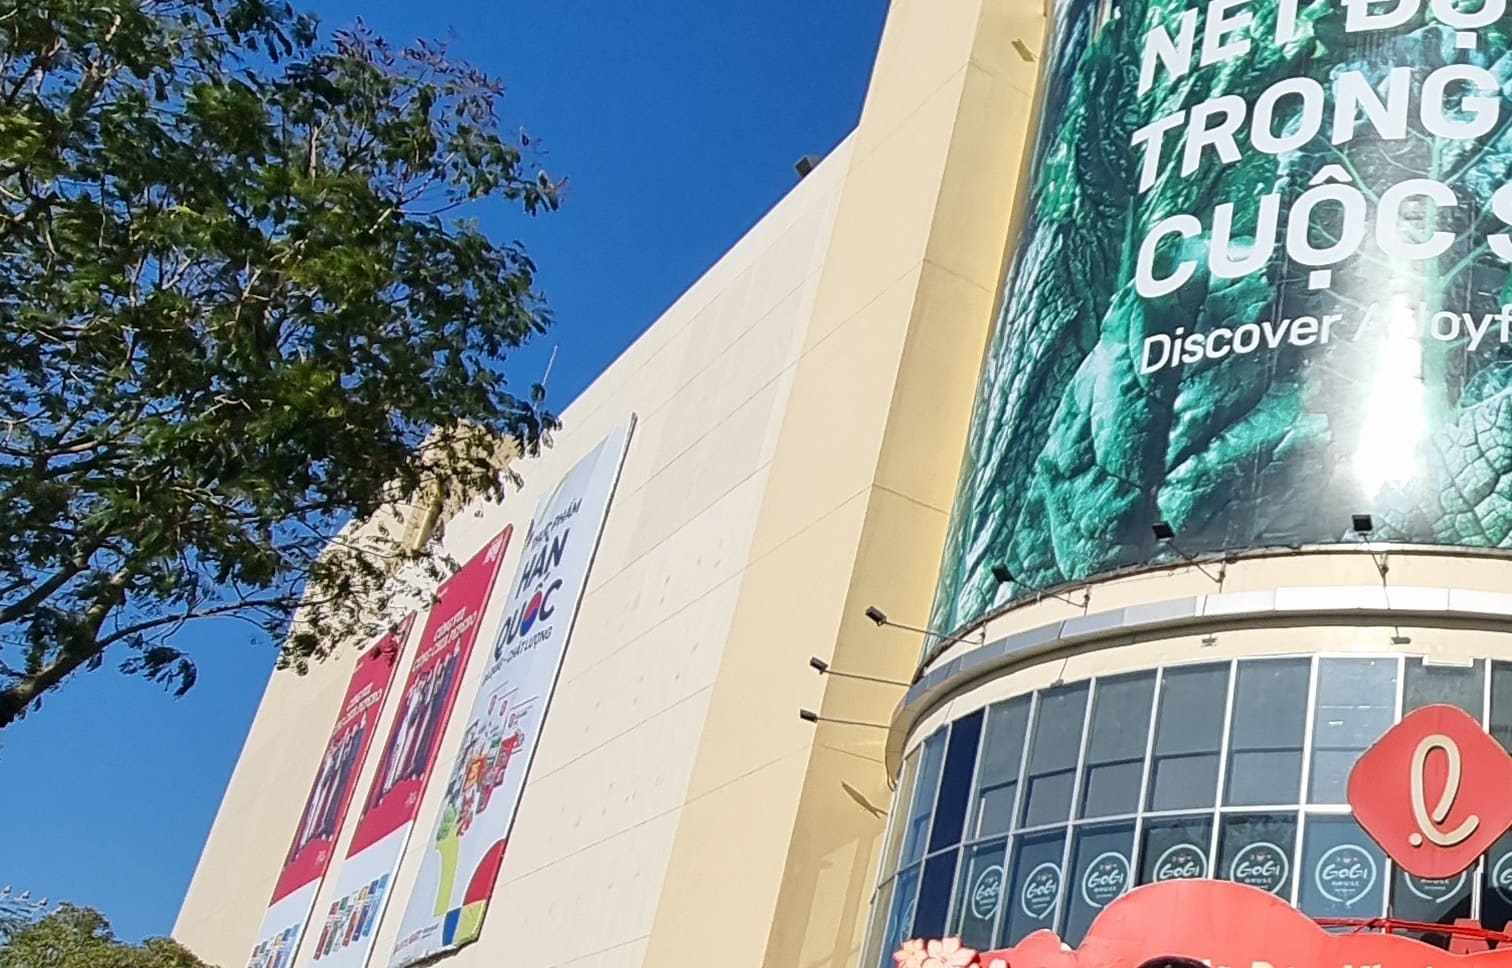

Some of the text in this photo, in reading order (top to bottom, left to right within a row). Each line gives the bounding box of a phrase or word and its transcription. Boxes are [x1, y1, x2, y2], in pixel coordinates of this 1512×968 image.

[1130, 64, 1500, 194] TRONG
[1134, 163, 1458, 300] CUỘC
[1139, 309, 1344, 376] Discover
